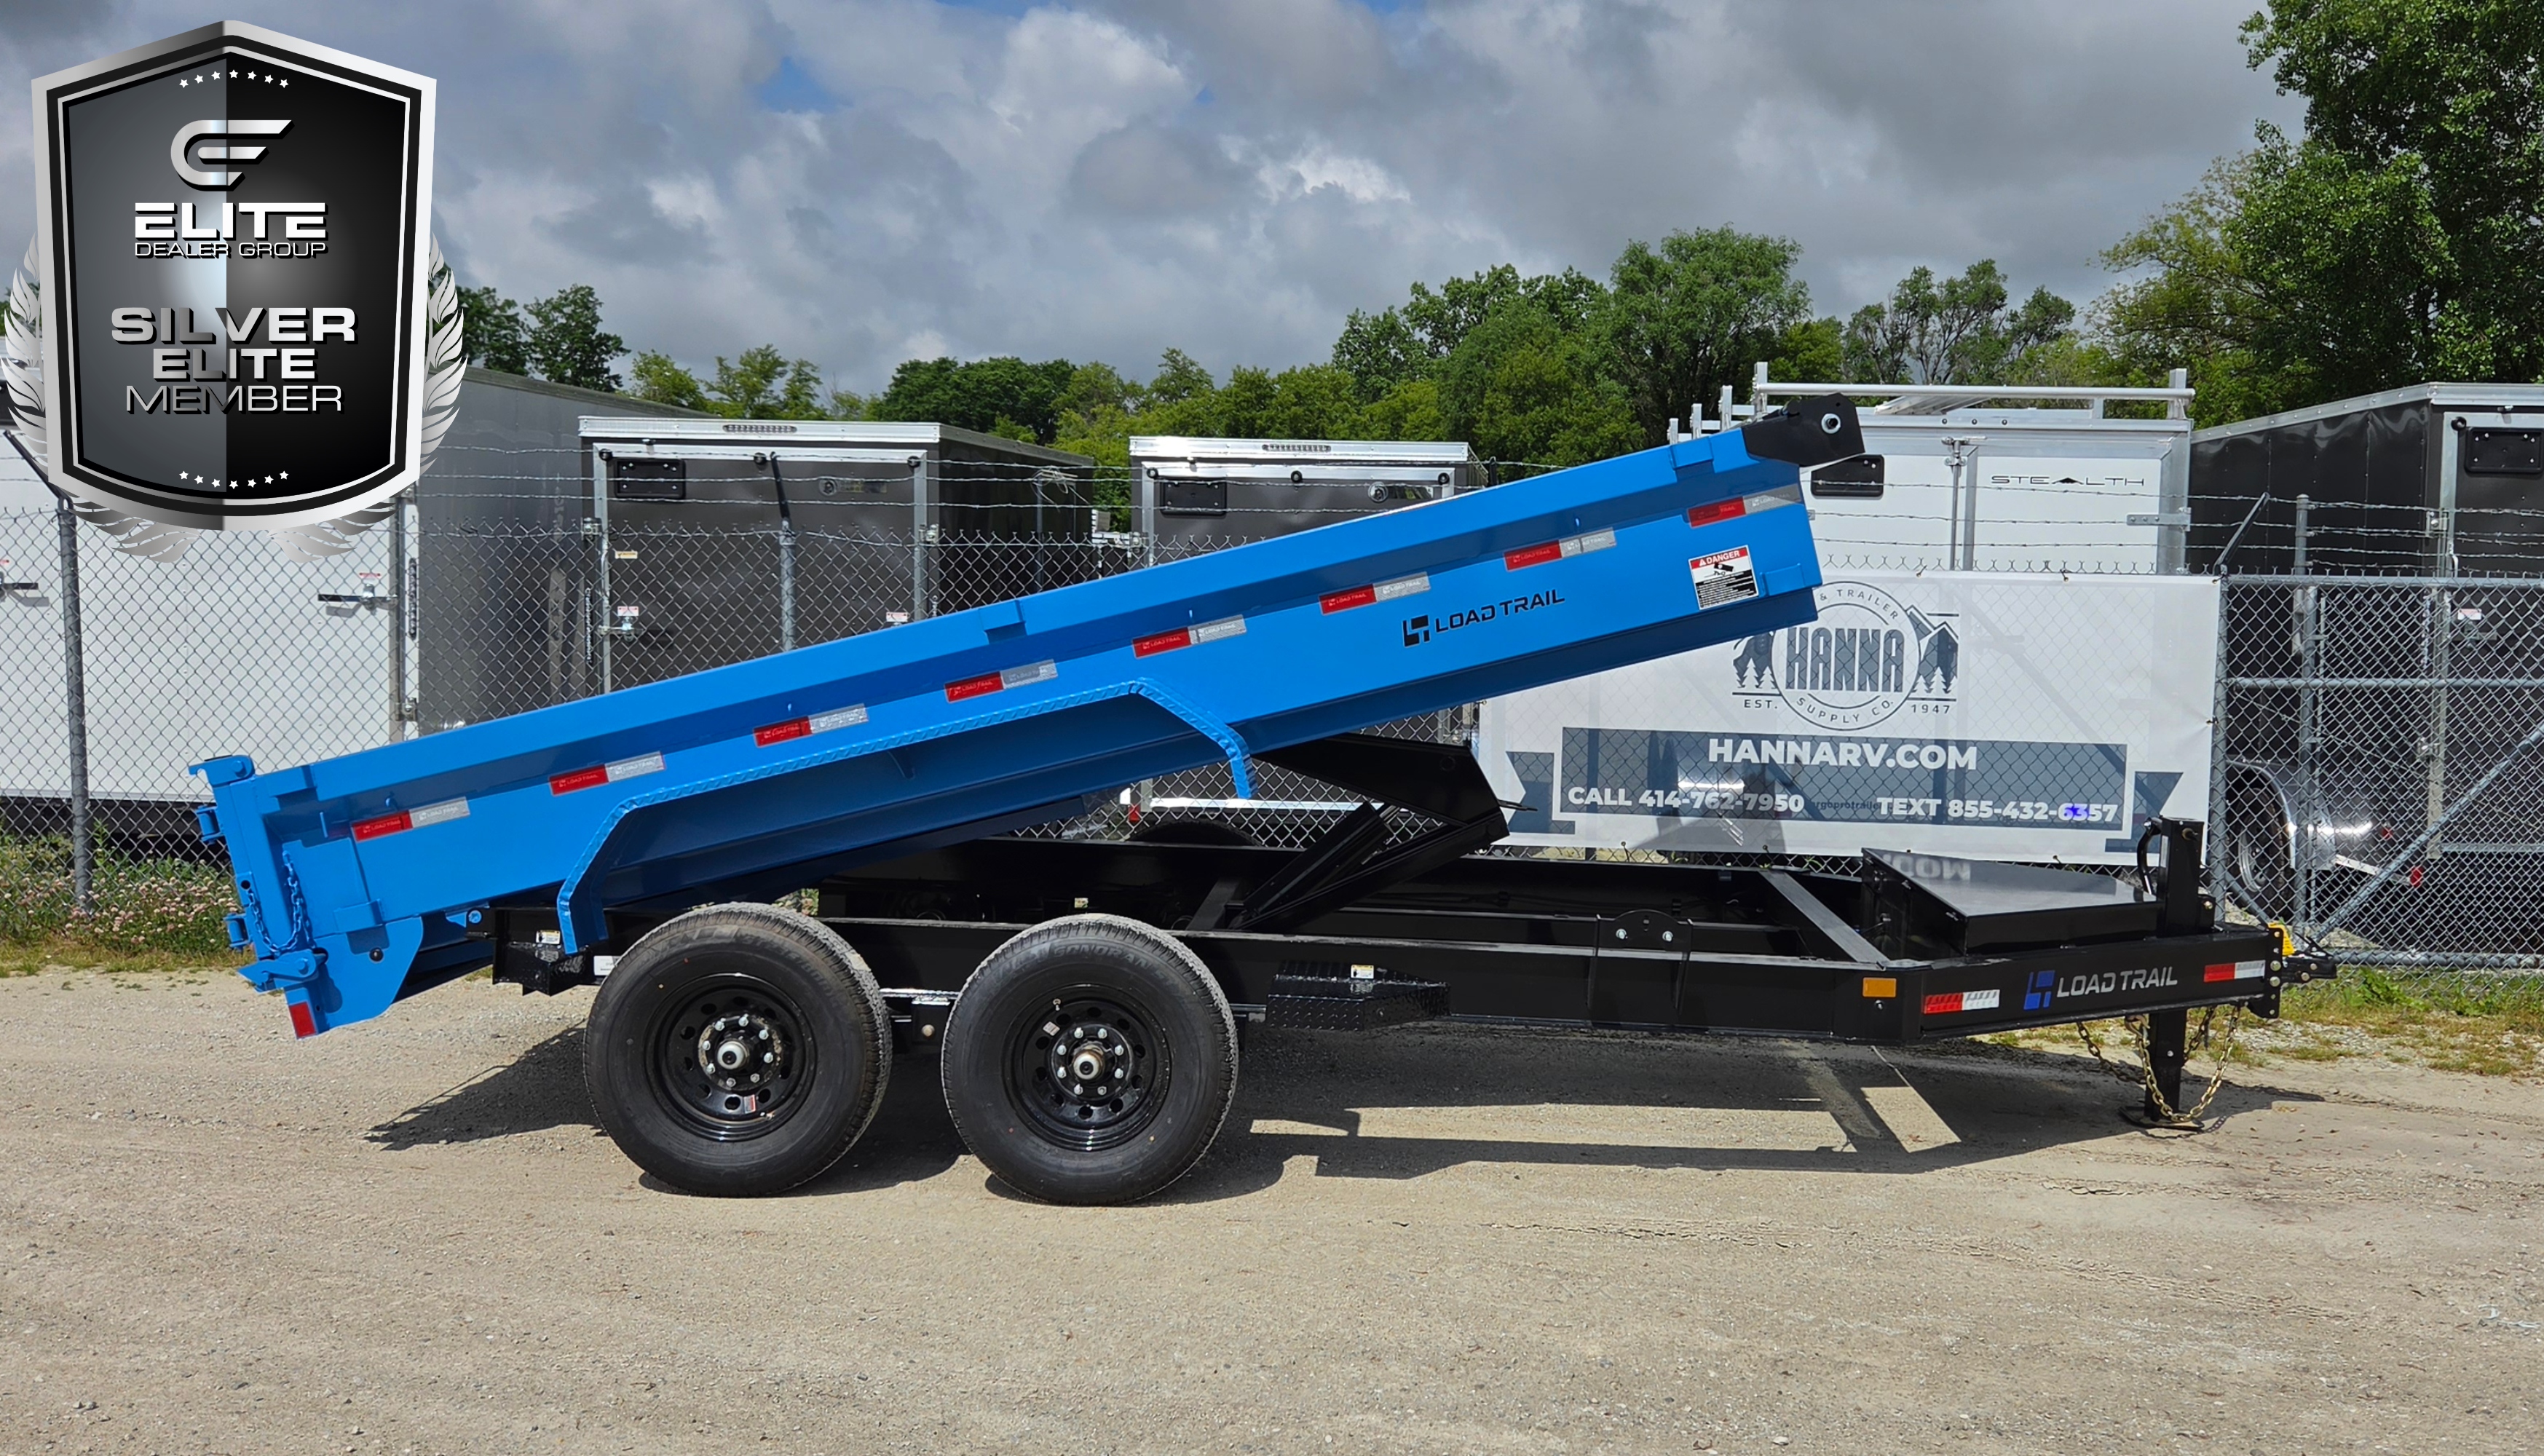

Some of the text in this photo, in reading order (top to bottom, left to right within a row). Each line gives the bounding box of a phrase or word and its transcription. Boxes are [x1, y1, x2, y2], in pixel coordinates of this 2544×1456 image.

[1706, 550, 1740, 564] DANGER
[1435, 589, 1565, 633] LOAD TRAIL
[1836, 588, 1899, 620] TRAILER
[1785, 627, 1905, 693] HANNA
[1744, 699, 1778, 710] EST.
[1796, 697, 1894, 724] SUPPLY CO.
[1911, 703, 1951, 714] 1947
[1708, 738, 1978, 770] HANNARV.COM
[1568, 786, 1805, 812] CALL 414-762-7950
[1876, 797, 2118, 822] TEXT 855-432-6357
[2056, 966, 2178, 997] LOAD TRAIL
